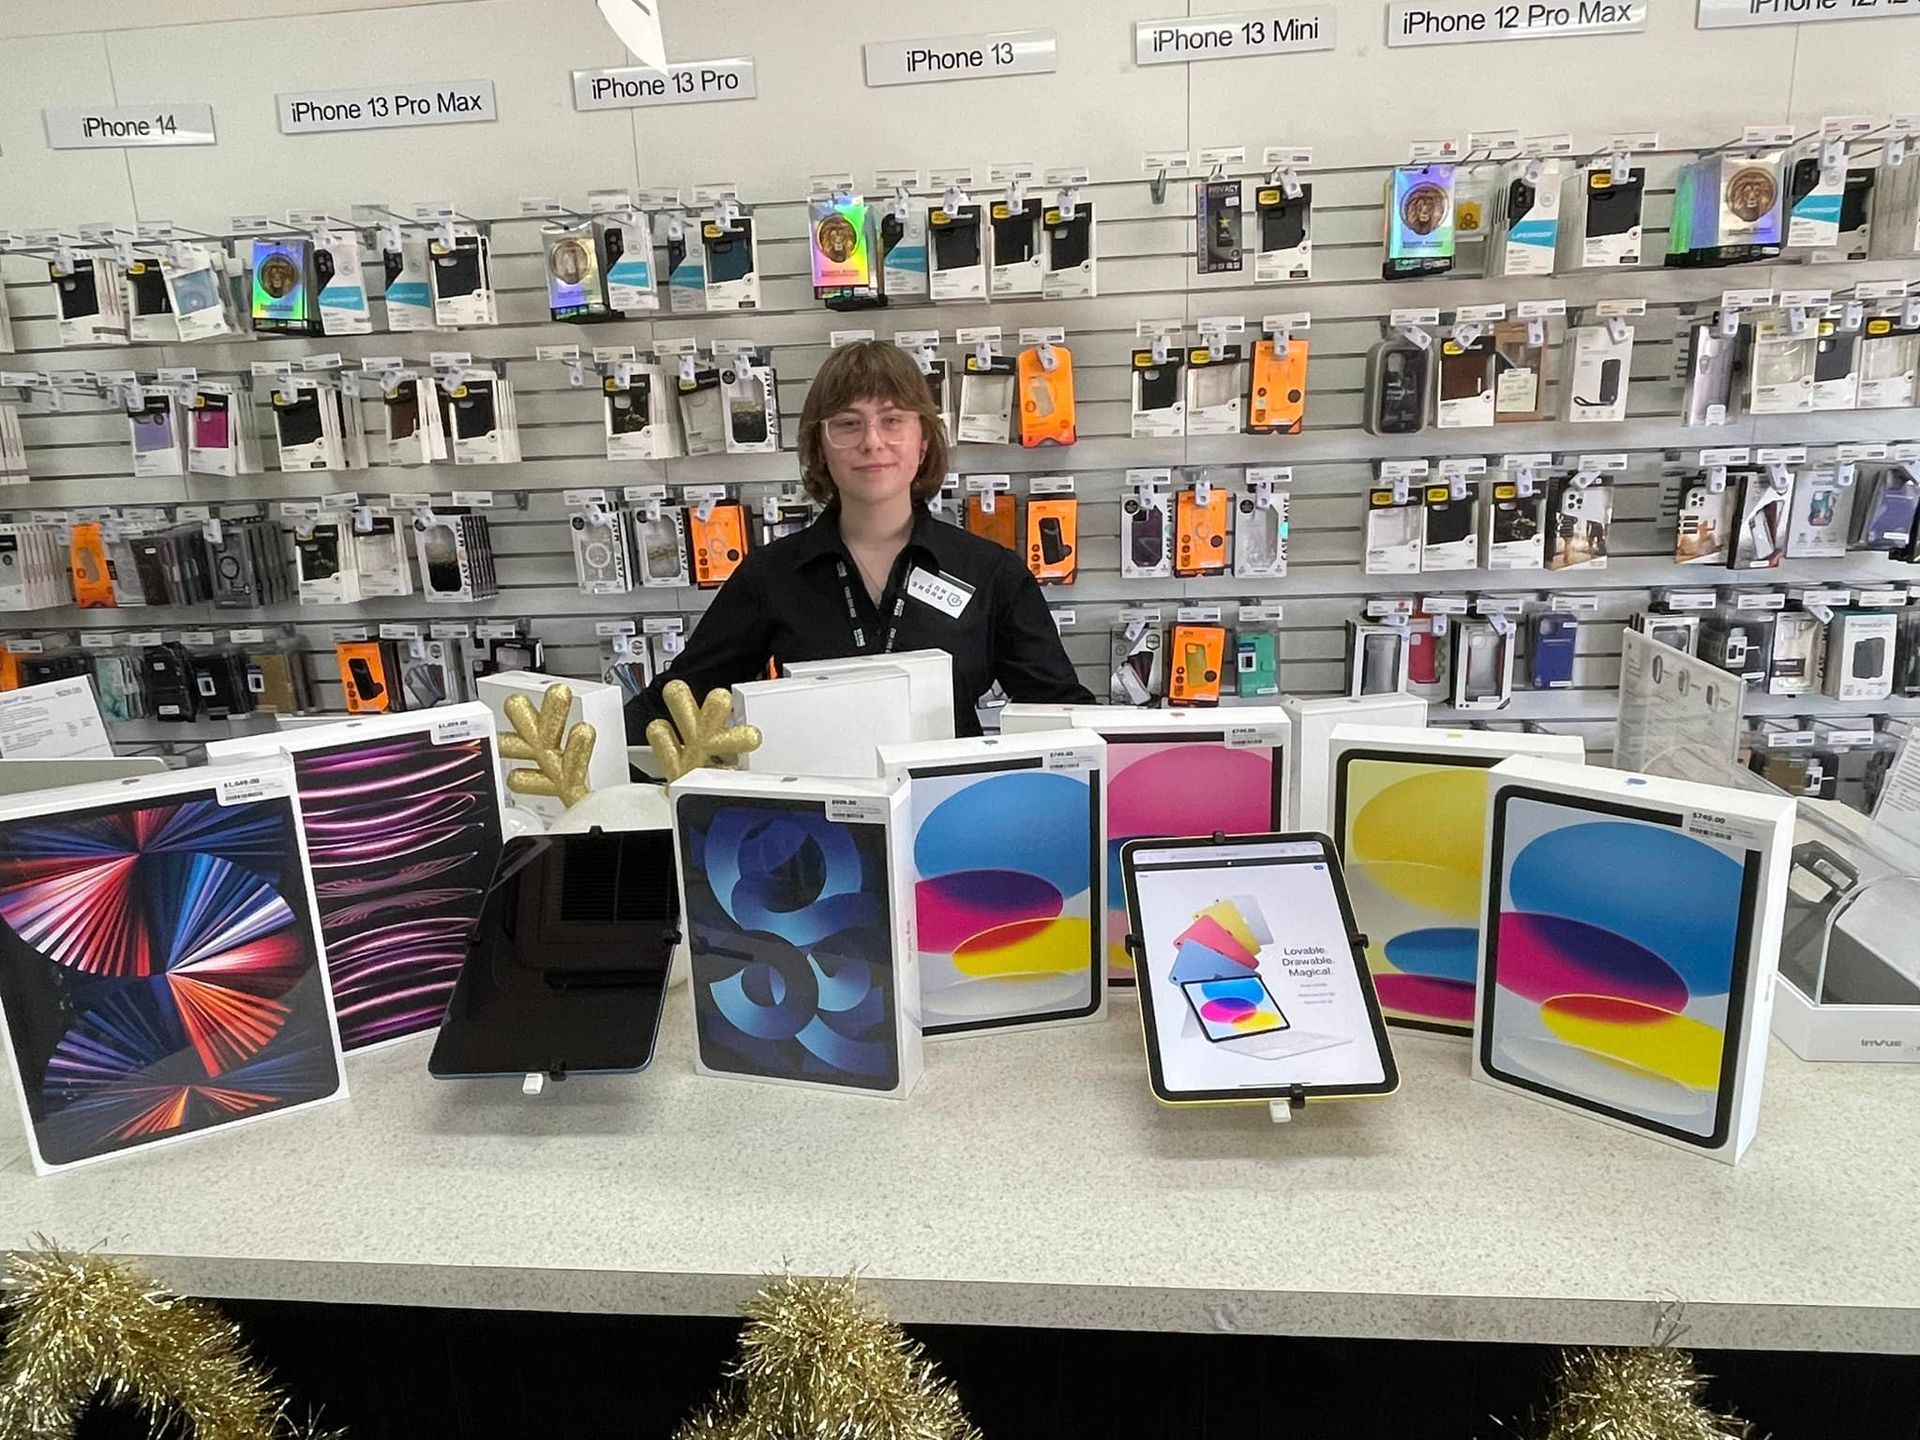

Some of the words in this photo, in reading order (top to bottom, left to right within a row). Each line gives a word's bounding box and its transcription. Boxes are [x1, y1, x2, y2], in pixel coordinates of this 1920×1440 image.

[1403, 8, 1486, 36] iPhone
[1494, 4, 1520, 30] 12
[1527, 2, 1570, 27] Pro
[1577, 1, 1633, 25] Max
[1152, 27, 1234, 53] iPhone
[1241, 22, 1265, 46] 13
[1272, 16, 1319, 43] Mini
[905, 48, 984, 72] iPhone
[990, 42, 1015, 66] 13
[591, 77, 666, 101] iPhone
[671, 72, 695, 95] 13
[700, 69, 739, 93] Pro
[291, 100, 361, 123] iPhone
[367, 96, 390, 118] 13
[395, 94, 431, 116] Pro
[437, 91, 483, 113] Max
[82, 117, 150, 139] iPhone
[155, 114, 177, 137] 14
[1281, 956, 1336, 967] Drawable.
[1288, 967, 1334, 977] Magical.
